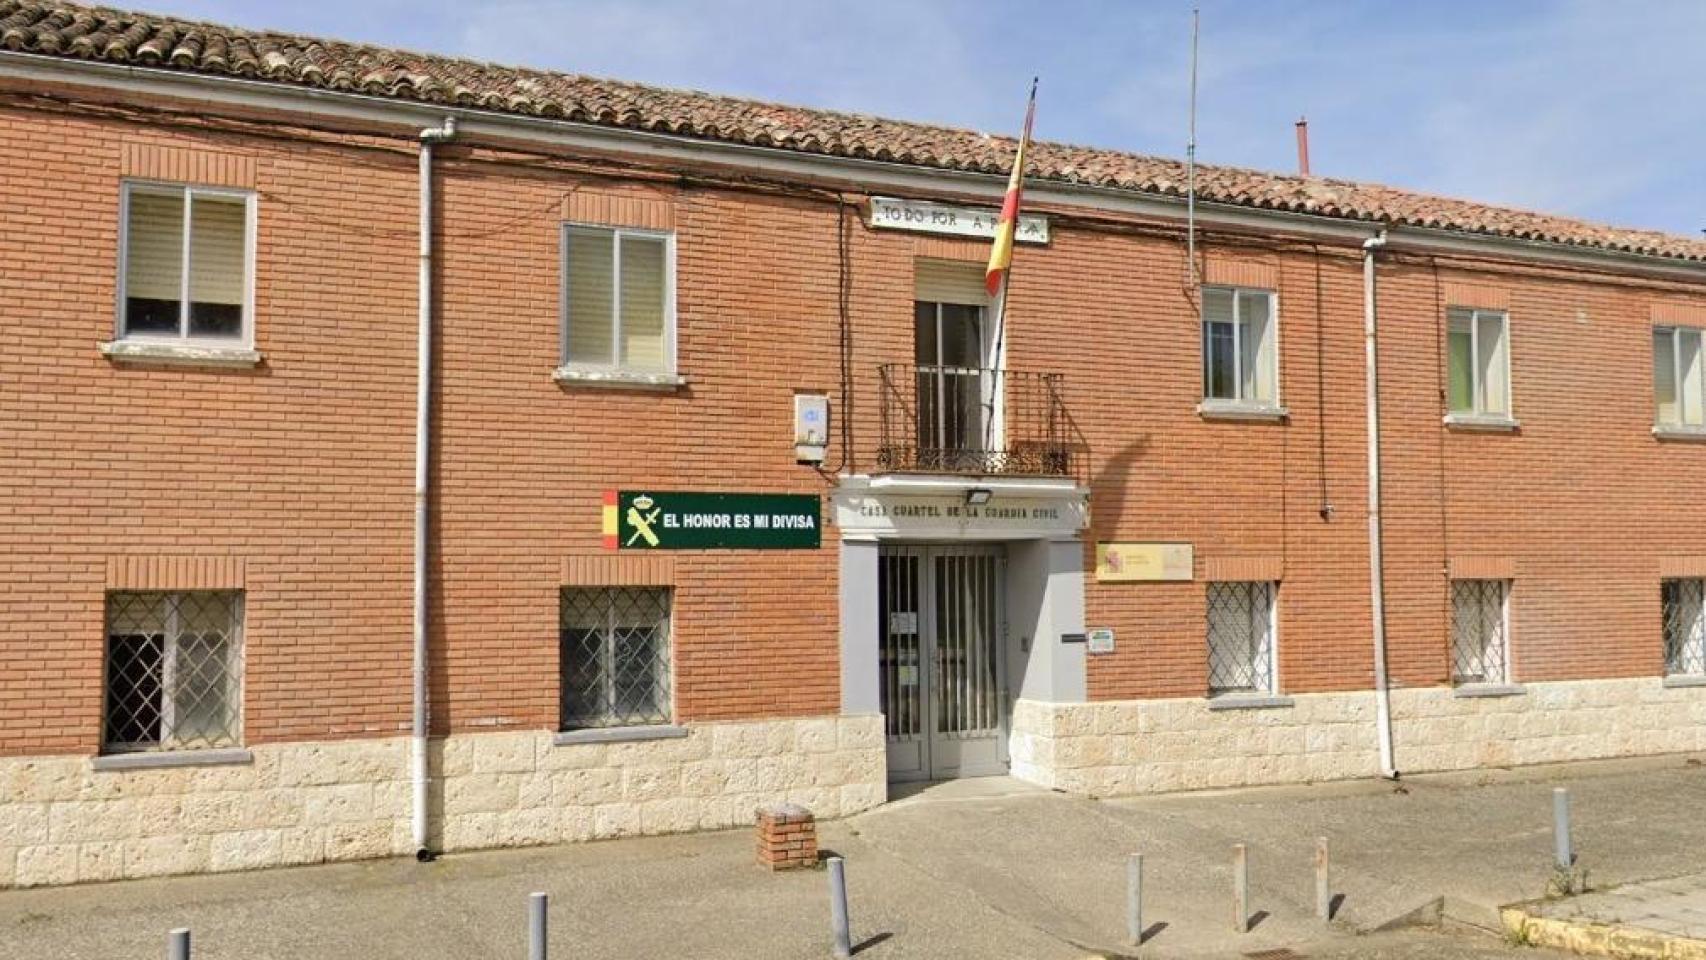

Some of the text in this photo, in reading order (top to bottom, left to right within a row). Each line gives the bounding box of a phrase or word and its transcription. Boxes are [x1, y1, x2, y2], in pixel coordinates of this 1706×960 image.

[893, 505, 942, 517] CUARTEL
[663, 513, 815, 529] EL HONOR ES MI DIVISA
